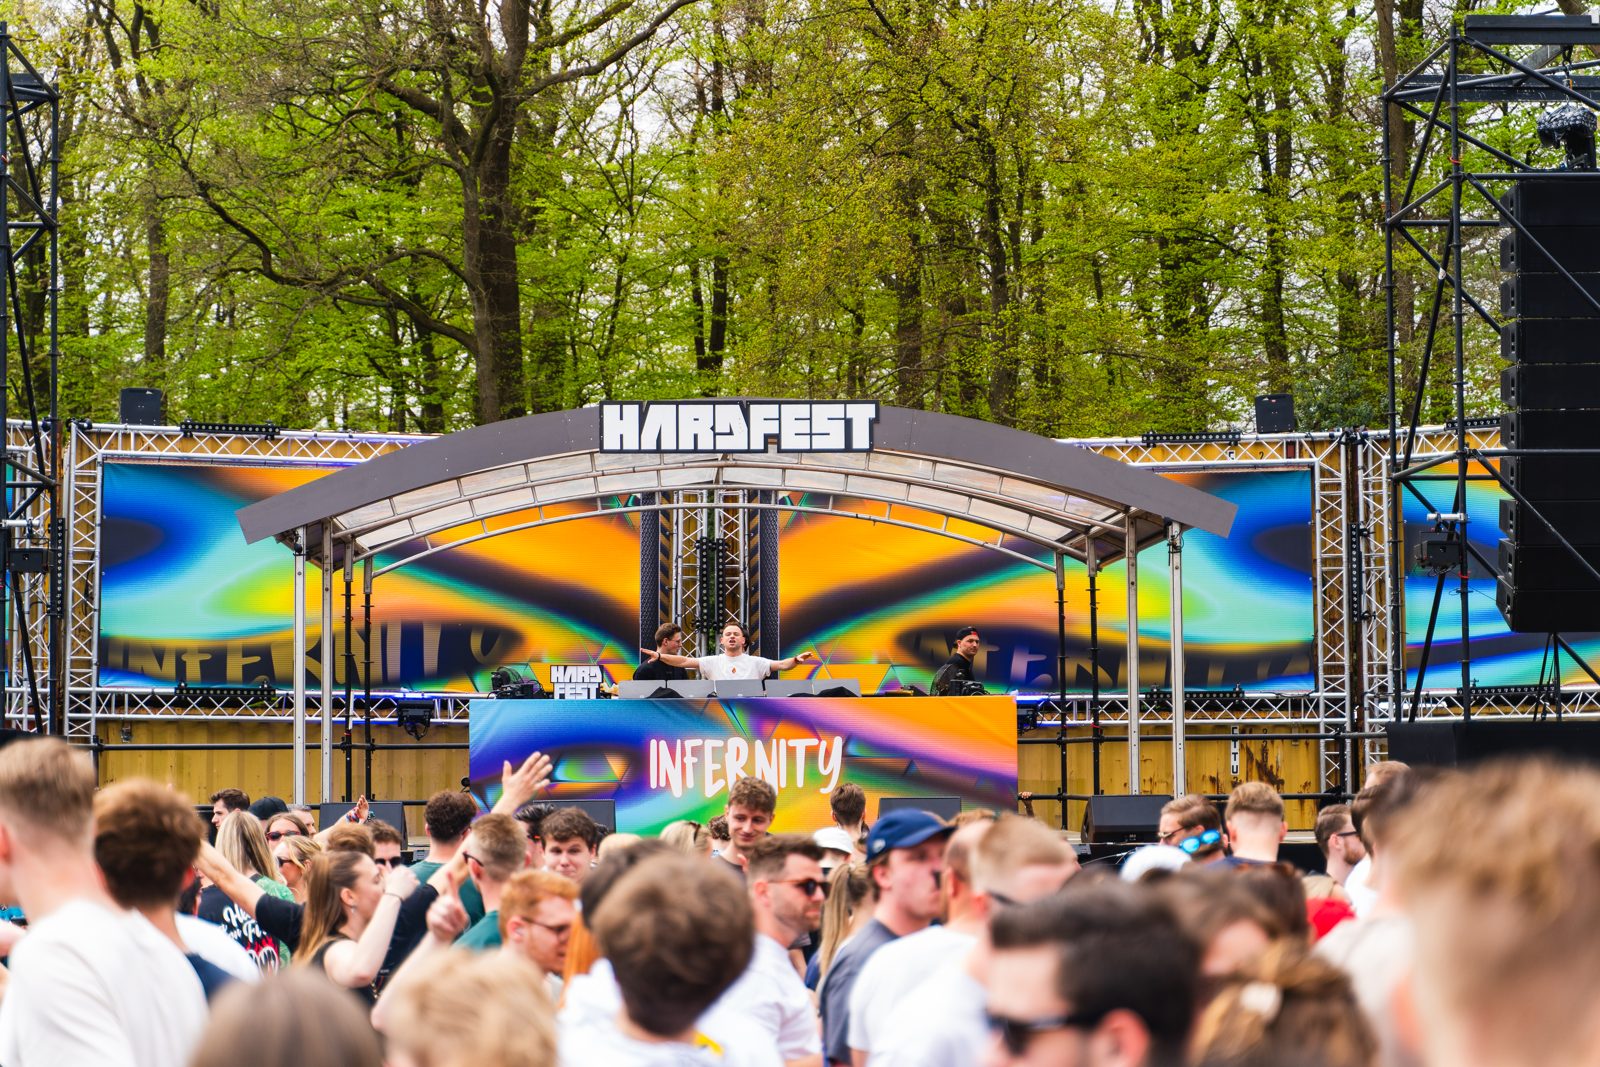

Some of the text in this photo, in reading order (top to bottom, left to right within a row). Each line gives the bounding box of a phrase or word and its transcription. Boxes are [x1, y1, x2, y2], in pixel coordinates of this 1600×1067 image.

[603, 403, 876, 450] HARDFEST
[551, 665, 602, 682] HARD
[554, 683, 599, 699] FEST
[649, 736, 843, 798] INFERNITY
